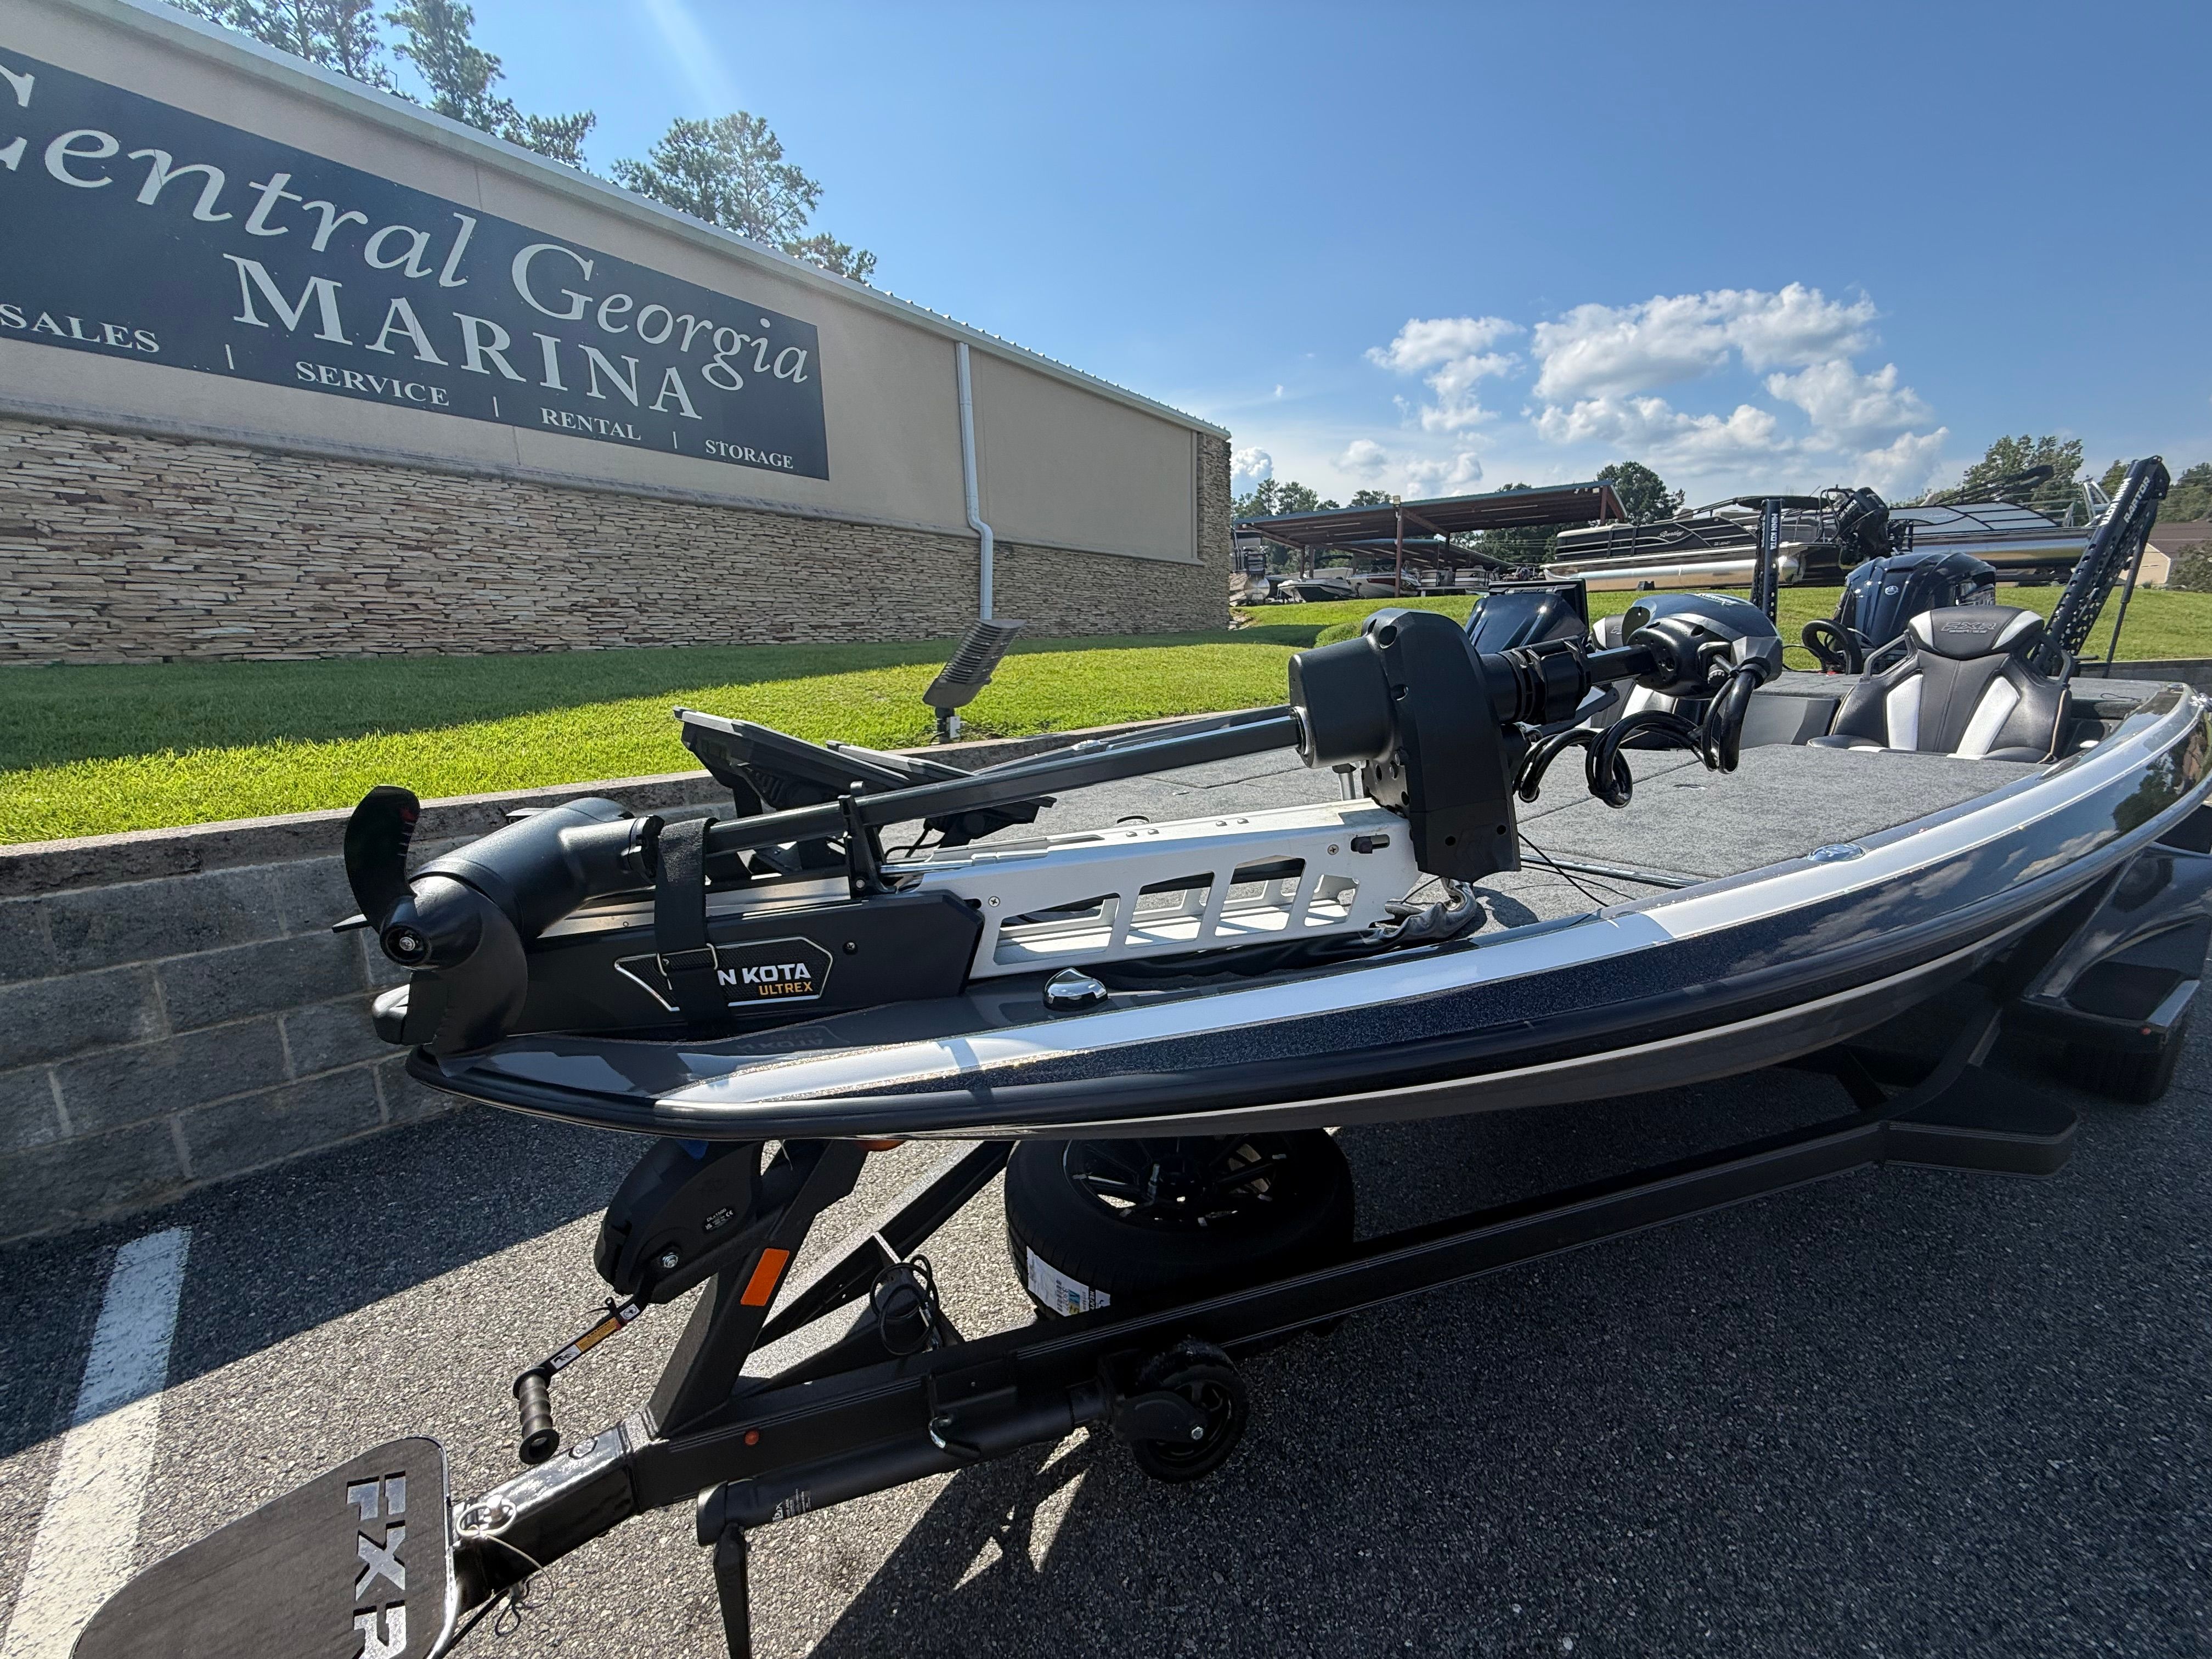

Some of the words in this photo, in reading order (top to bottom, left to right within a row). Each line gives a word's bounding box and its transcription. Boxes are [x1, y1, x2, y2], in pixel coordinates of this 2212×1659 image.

[0, 304, 160, 353] SALES
[296, 361, 449, 407] SERVICE
[540, 407, 641, 441] RENTAL
[705, 439, 793, 470] STORAGE
[223, 253, 702, 420] MARINA
[512, 243, 808, 391] Georgia
[2123, 476, 2151, 523] RAPTOR
[743, 962, 812, 985] KOTA
[759, 981, 813, 996] ULTREX
[346, 1470, 407, 1659] FXR
